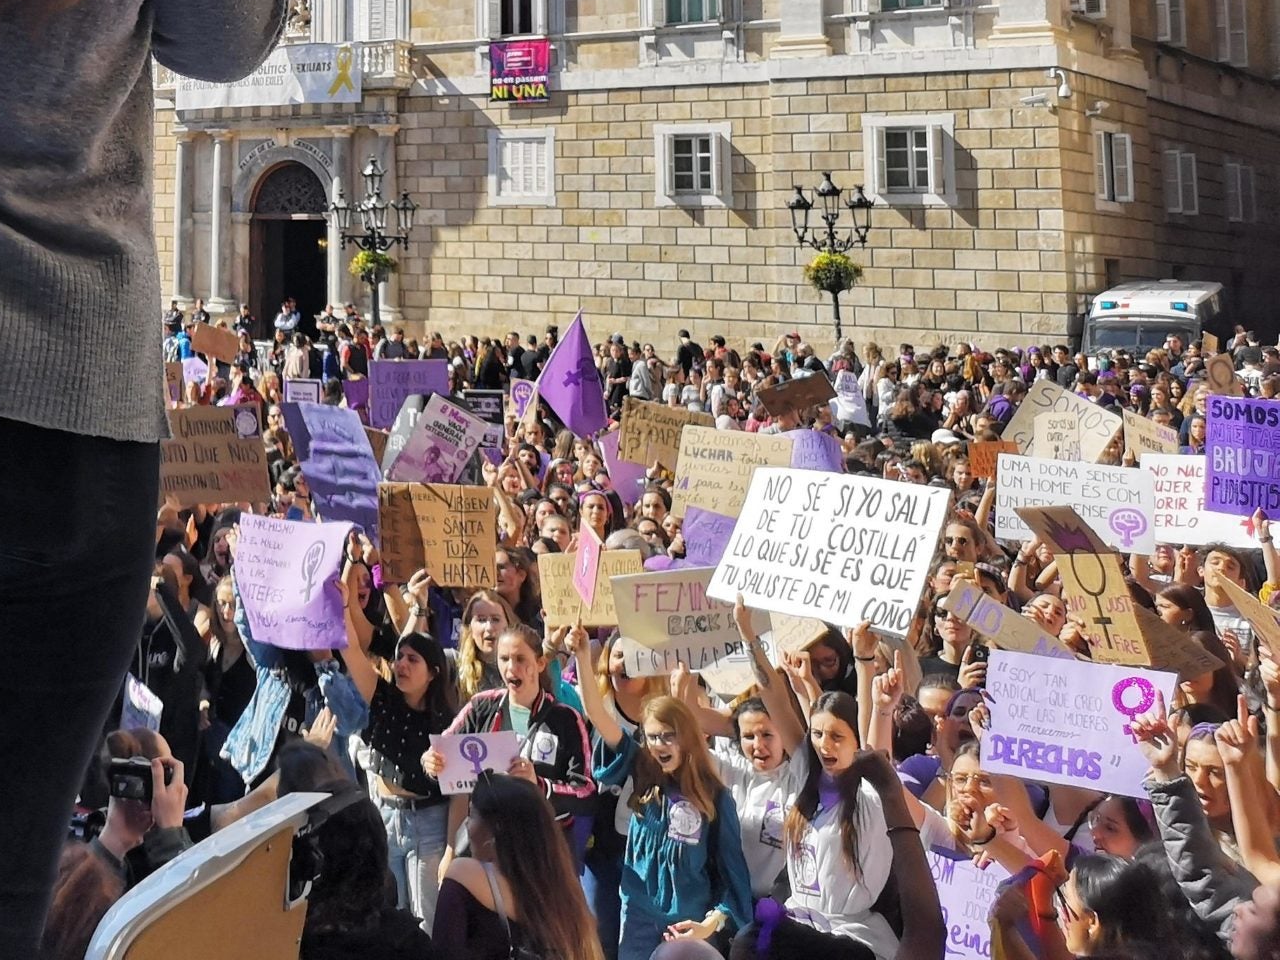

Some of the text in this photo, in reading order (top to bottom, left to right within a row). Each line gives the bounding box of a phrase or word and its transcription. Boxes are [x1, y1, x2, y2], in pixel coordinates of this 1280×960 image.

[296, 61, 332, 74] EXILIATS
[251, 77, 265, 87] AND
[265, 76, 284, 86] EXILES
[492, 83, 548, 99] NI UNA
[1211, 399, 1280, 427] SOMOS
[227, 442, 260, 464] NOS
[684, 447, 734, 463] LUCHAR
[1001, 459, 1130, 486] UNA DONA SENSE
[1149, 464, 1169, 478] NO
[1000, 475, 1142, 504] UN HOME ÉS COM
[1154, 480, 1192, 493] UJER
[442, 489, 490, 511] VIRGEN
[763, 475, 941, 527] NO SÉ SI YO SALÍ
[998, 494, 1020, 509] UN
[1153, 495, 1188, 511] ORIR
[442, 517, 485, 535] SANTA
[756, 508, 781, 534] DE
[789, 513, 813, 541] TU
[1153, 514, 1199, 529] ERLO
[442, 539, 480, 557] TUYA
[732, 532, 755, 558] LO
[757, 539, 791, 564] QUE
[789, 543, 810, 568] SI
[840, 557, 864, 583] ES
[870, 563, 916, 592] QUE
[442, 562, 491, 585] HARTA
[721, 563, 741, 586] TU
[738, 567, 803, 601] SALISTE
[803, 581, 830, 608] DE
[829, 589, 853, 615] MI
[861, 597, 914, 631] COÑO
[667, 613, 722, 636] BACK
[1044, 673, 1069, 689] TAN
[991, 680, 1103, 714] RADICAL QUE CREO
[1007, 703, 1109, 732] QUE LAS MUJERES
[986, 733, 1103, 781] DERECHOS
[975, 887, 992, 903] LAS
